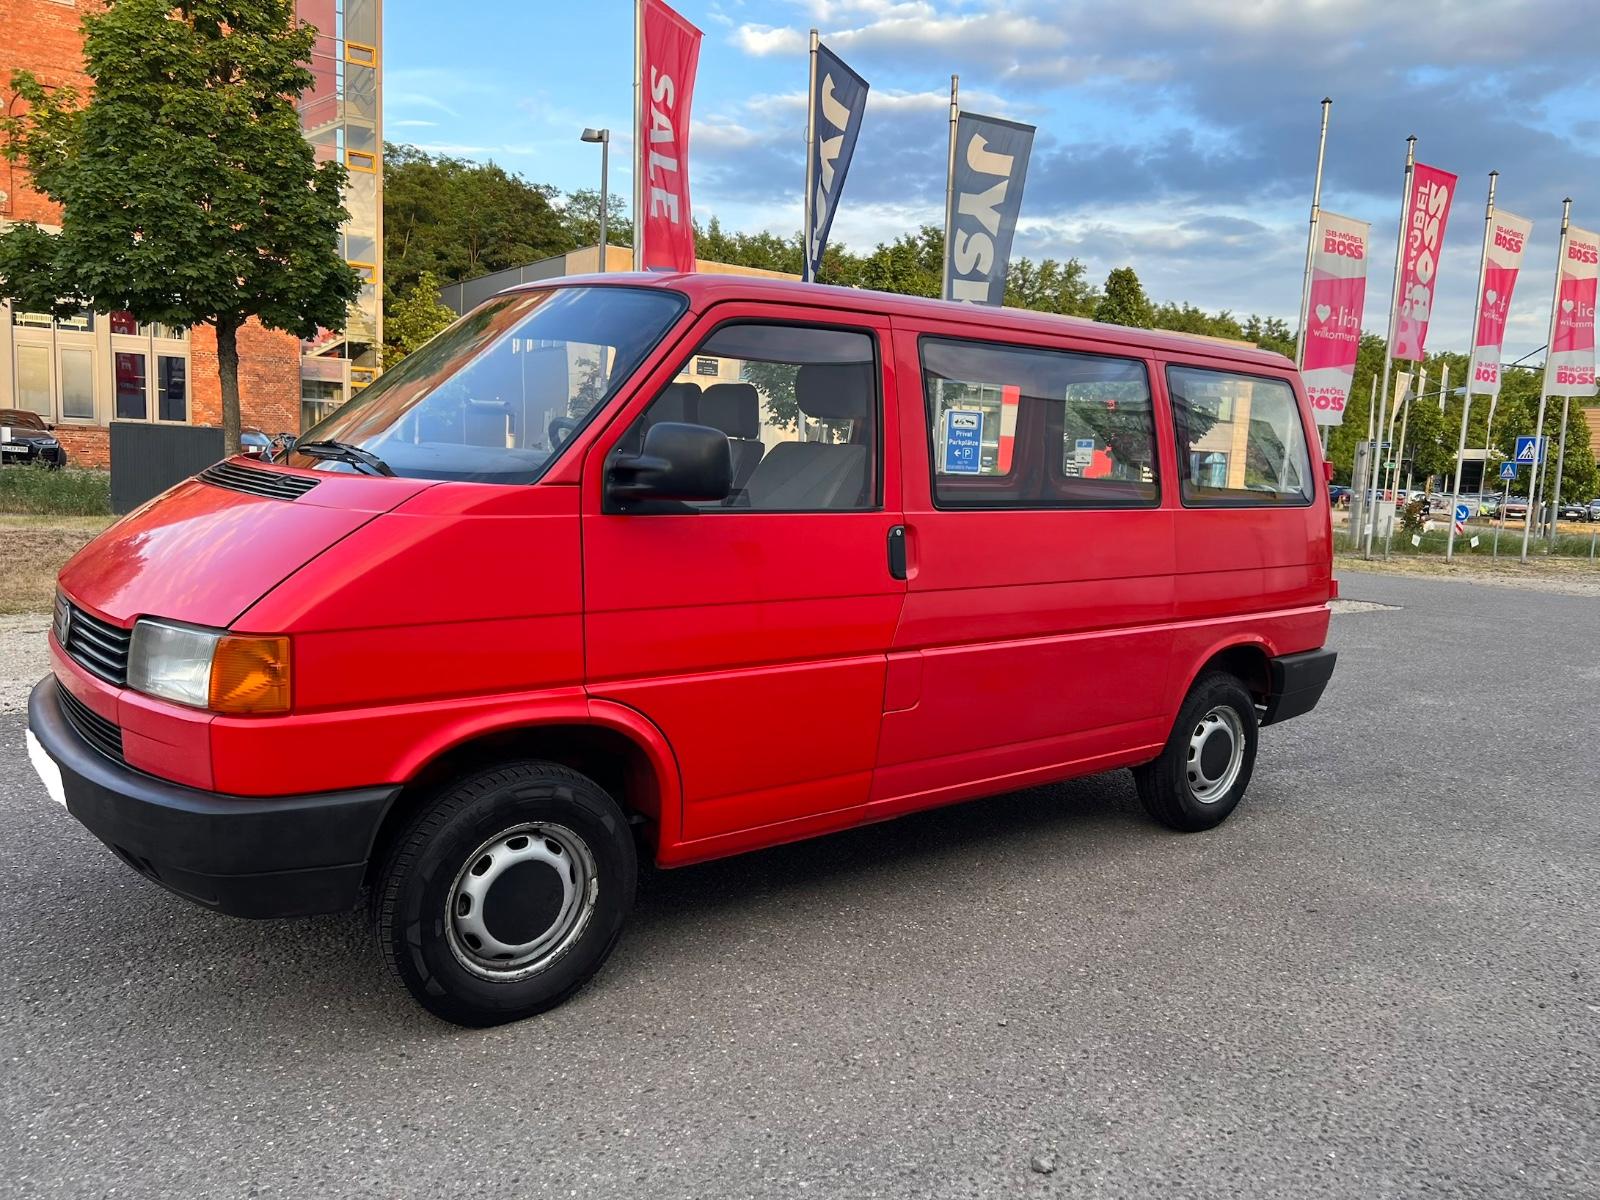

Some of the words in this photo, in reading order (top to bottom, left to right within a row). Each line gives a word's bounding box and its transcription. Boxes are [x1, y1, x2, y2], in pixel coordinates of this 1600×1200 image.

[650, 64, 679, 225] SALE
[1325, 229, 1365, 245] SB-MÖBEL
[1494, 231, 1523, 254] BOSS
[1323, 237, 1364, 260] BOSS
[1401, 179, 1431, 318] SB-MÖBEL
[1411, 181, 1449, 322] BOSS
[1567, 246, 1598, 264] BOSS
[1475, 367, 1497, 383] BOS
[1556, 371, 1596, 385] BOSS
[948, 438, 979, 447] Parkplätze
[955, 430, 973, 438] Privat
